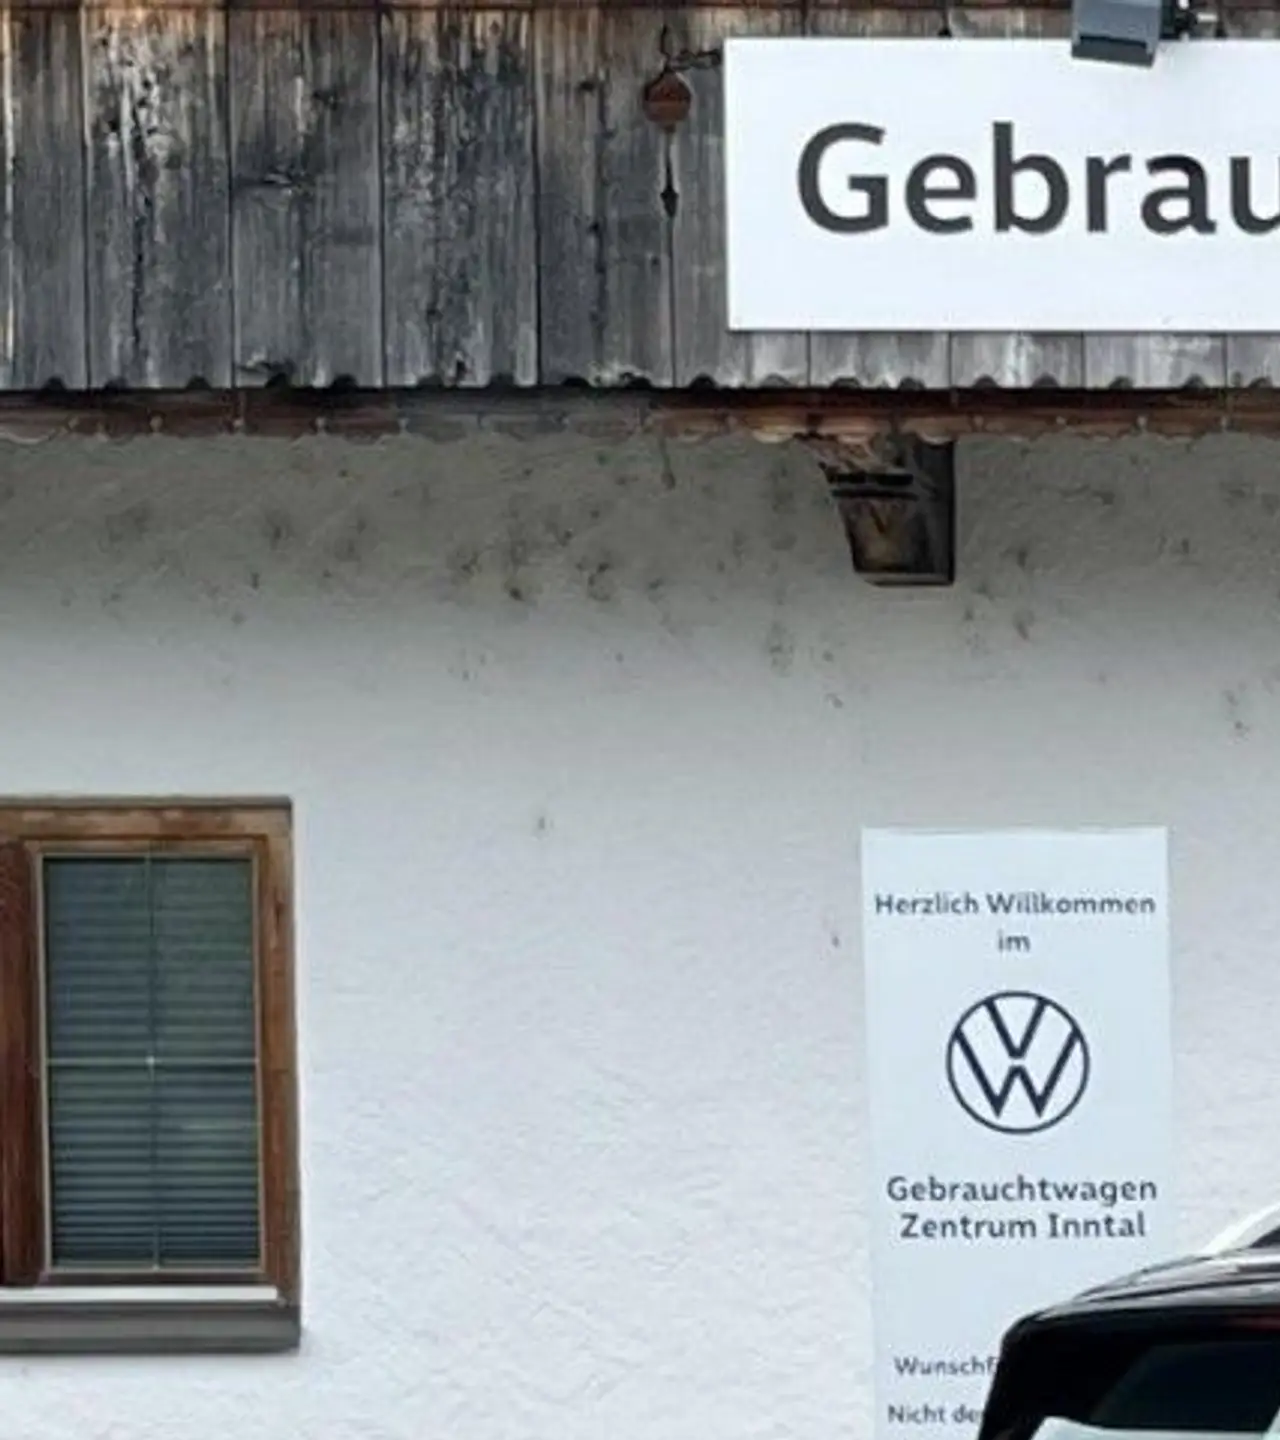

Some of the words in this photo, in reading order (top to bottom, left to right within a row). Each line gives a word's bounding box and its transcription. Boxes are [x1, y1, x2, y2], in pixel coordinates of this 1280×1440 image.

[874, 891, 980, 915] Herzlich
[986, 891, 1157, 915] Willkommen
[998, 931, 1031, 952] im
[946, 991, 1090, 1135] VW
[886, 1174, 1158, 1209] Gebrauchtwagen
[900, 1212, 1038, 1240] Zentrum
[1047, 1208, 1146, 1239] Inntal
[887, 1404, 946, 1424] Nicht
[953, 1404, 984, 1424] de
